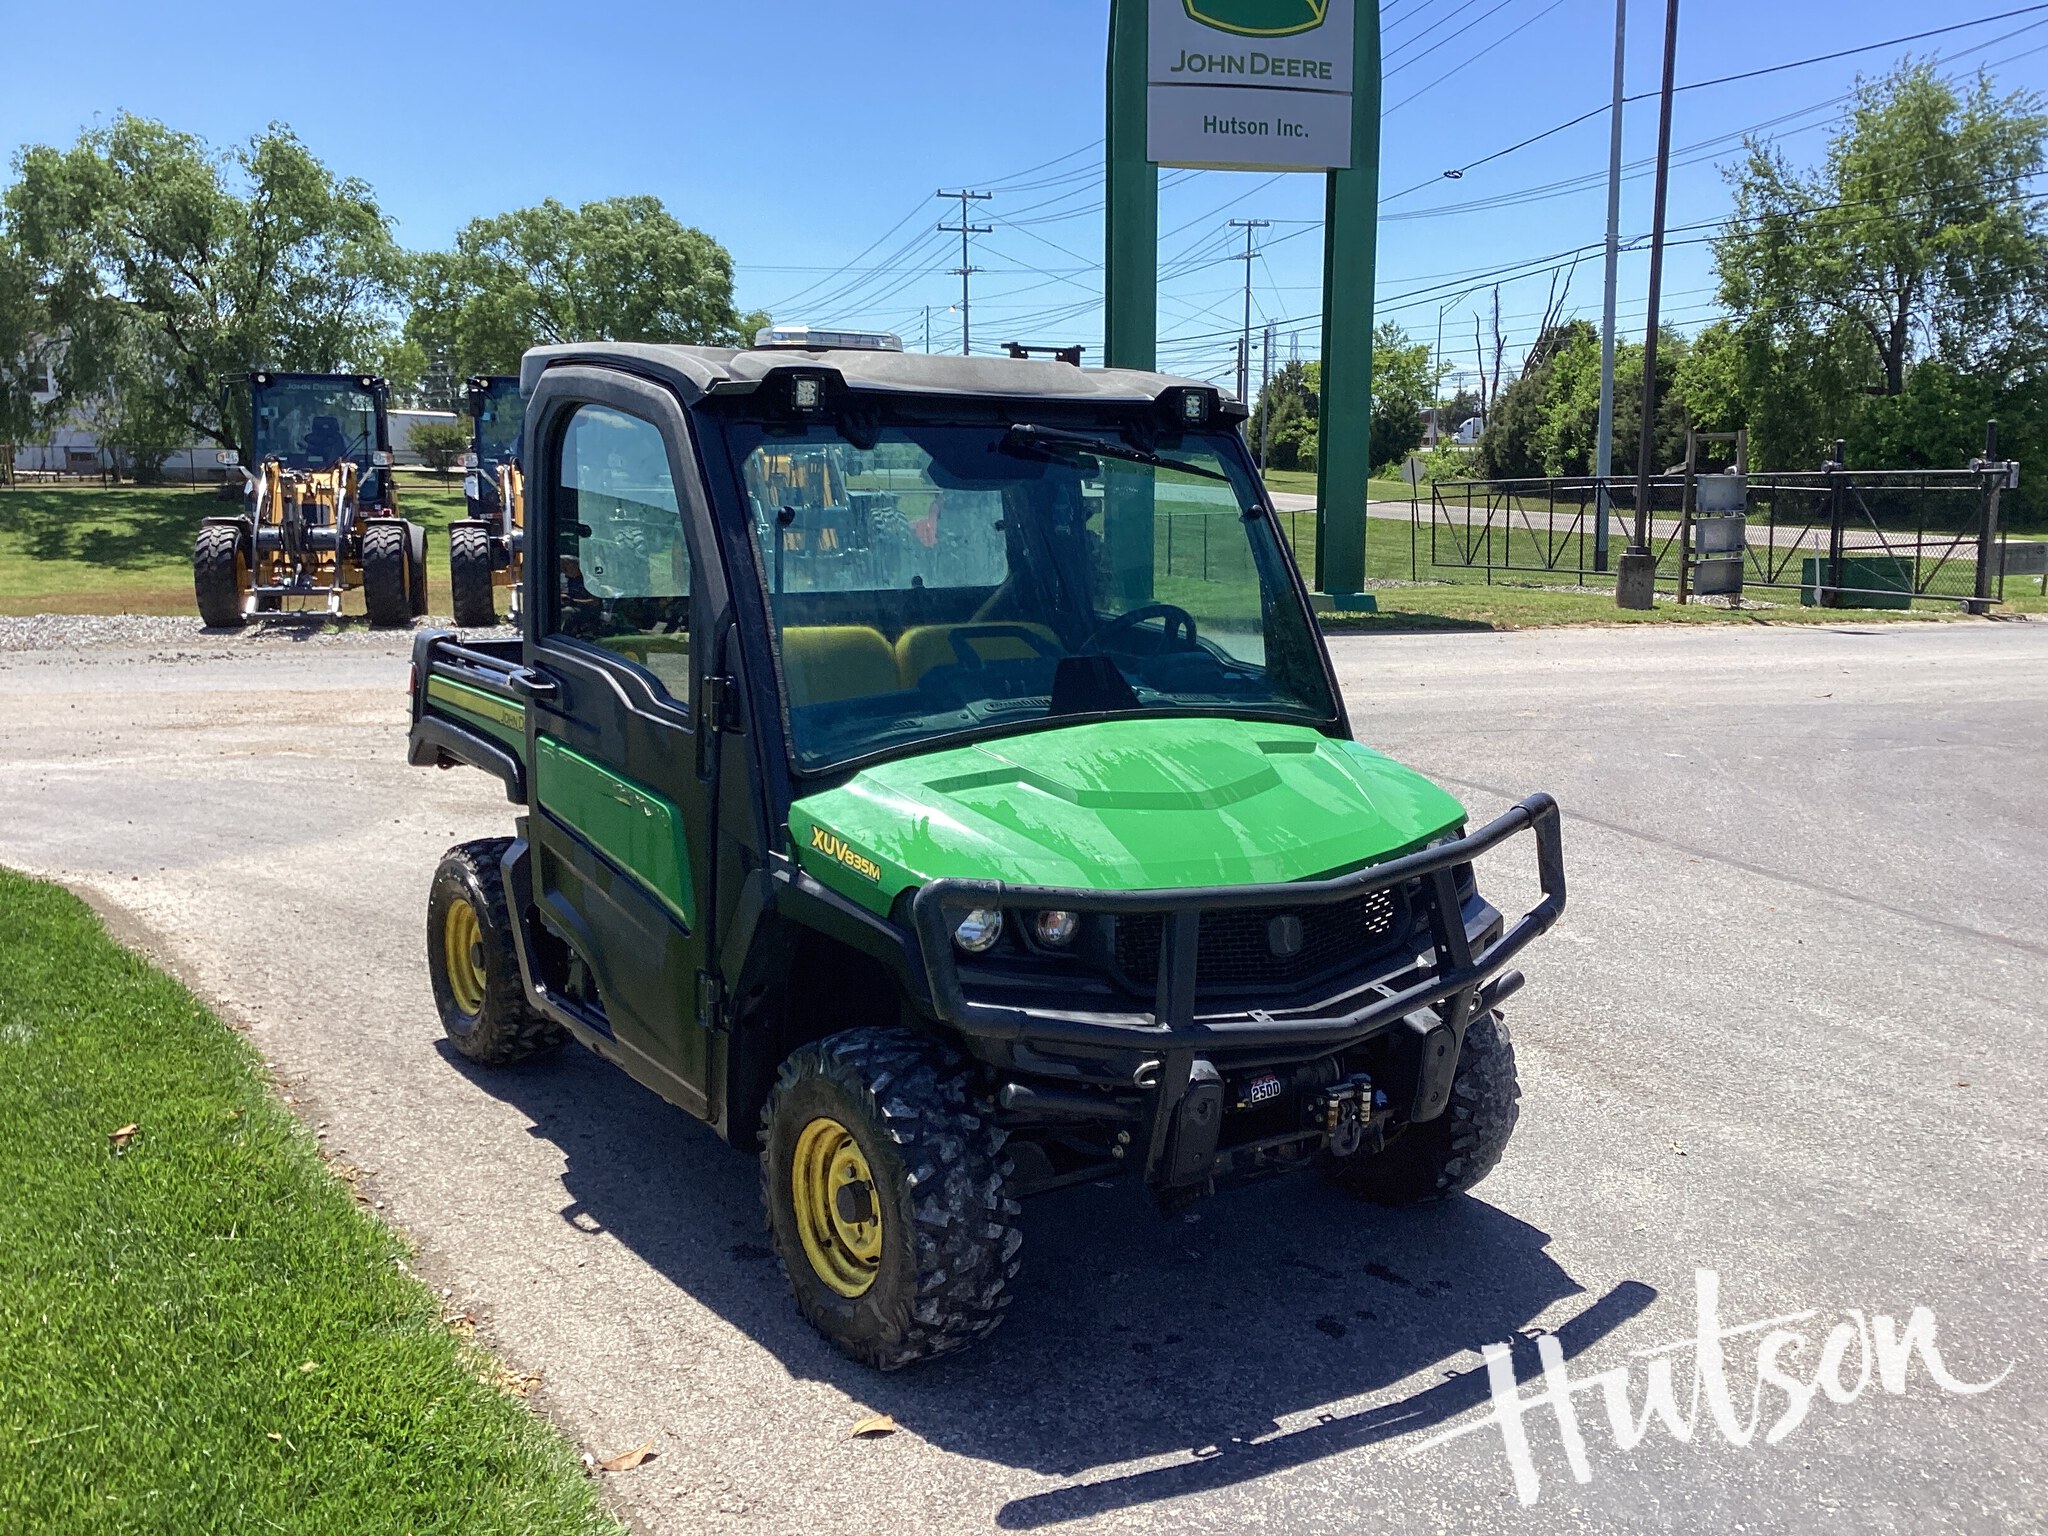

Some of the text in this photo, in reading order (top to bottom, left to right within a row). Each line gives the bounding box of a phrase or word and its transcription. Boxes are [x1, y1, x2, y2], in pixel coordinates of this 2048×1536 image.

[1170, 50, 1332, 80] JOHN DEERE
[1203, 115, 1309, 138] Hutson Inc.
[812, 826, 881, 881] XUV835M
[1252, 1082, 1279, 1100] 2500
